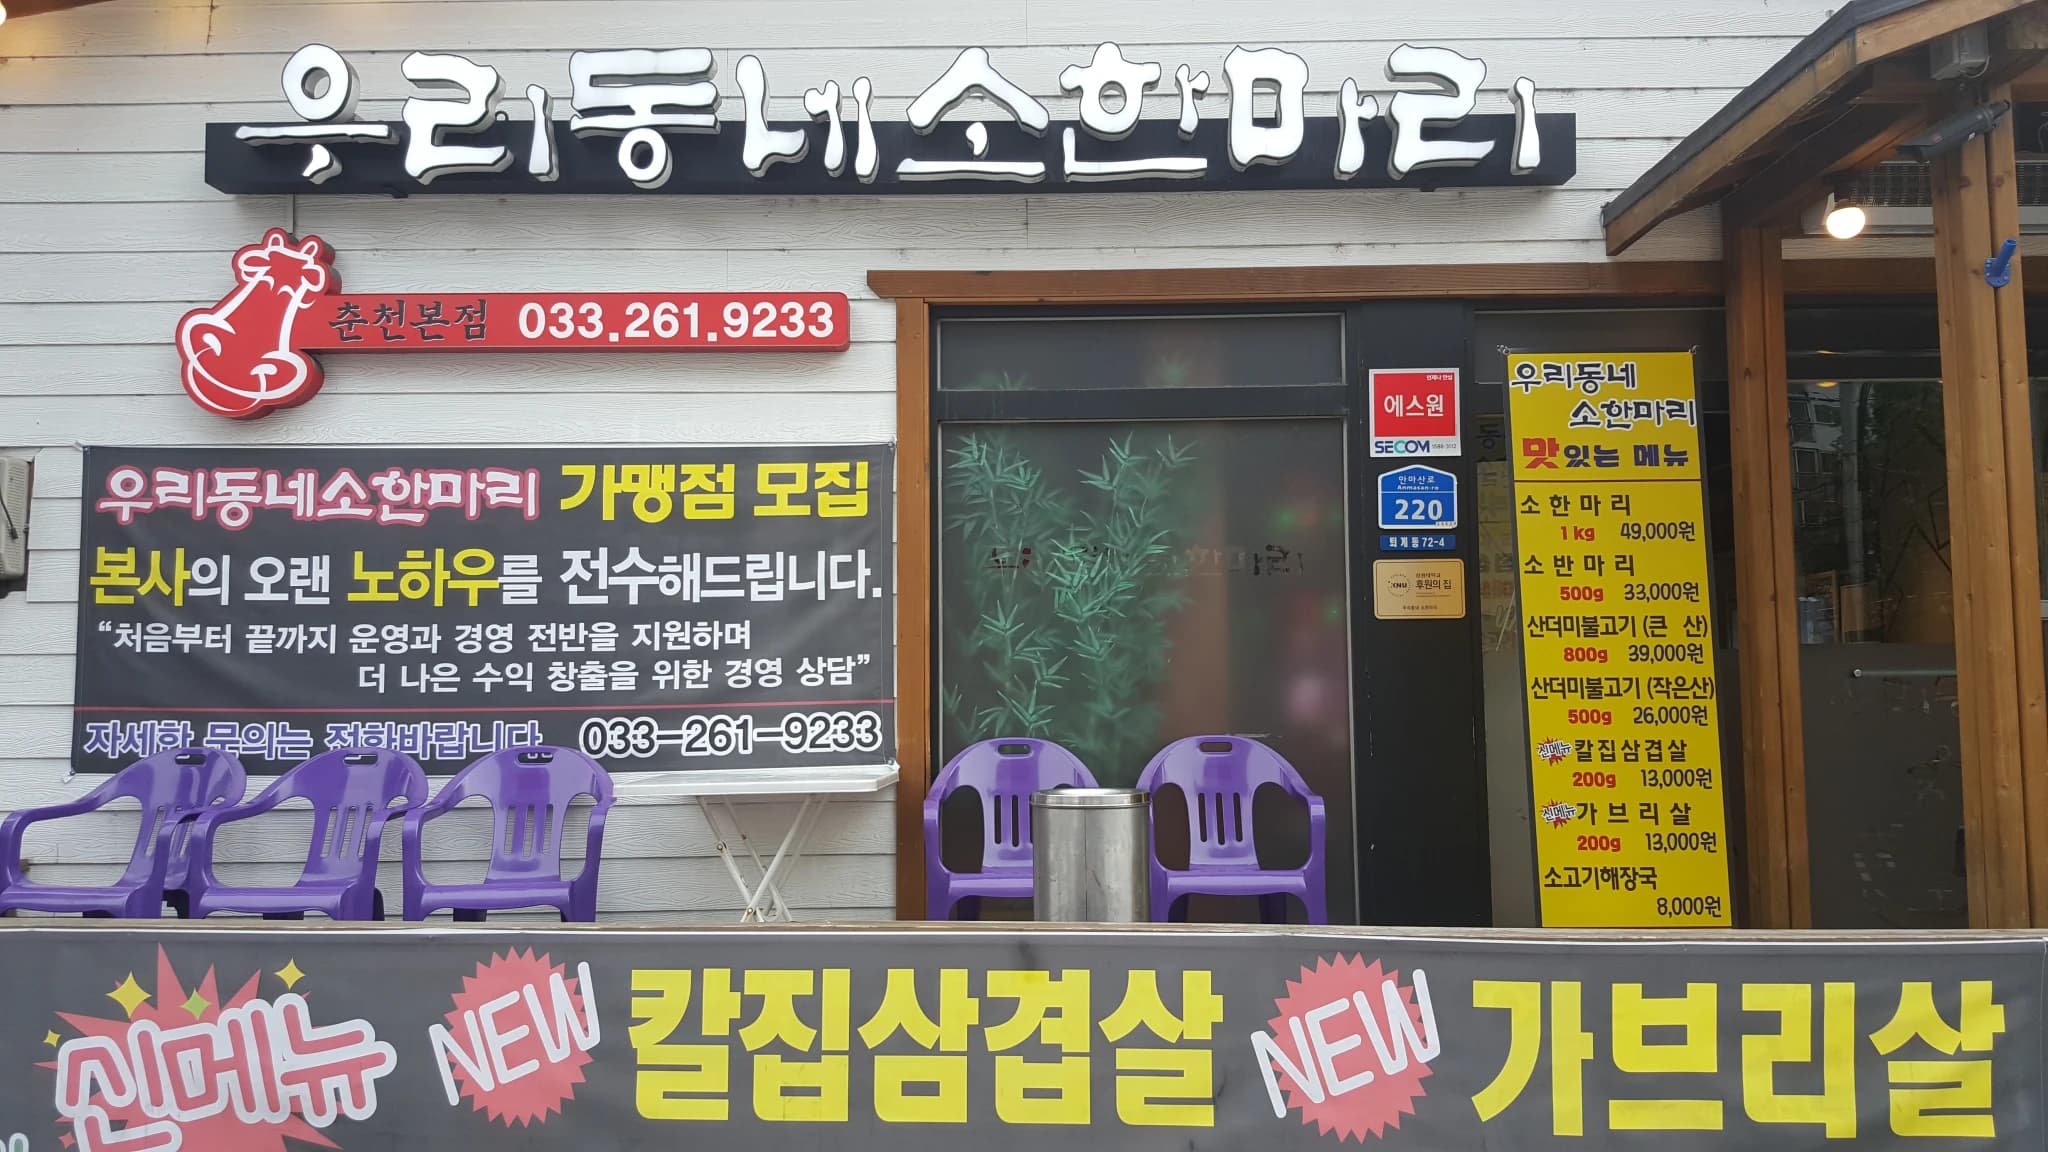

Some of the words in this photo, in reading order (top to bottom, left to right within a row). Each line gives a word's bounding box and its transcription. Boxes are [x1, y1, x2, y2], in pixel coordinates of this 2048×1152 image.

[235, 42, 1540, 188] 우리동네소한마리
[328, 298, 488, 342] 춘천본점
[517, 301, 835, 342] 033.261.9233
[1510, 361, 1637, 394] 우리동네
[1383, 393, 1444, 417] 에스원
[1568, 399, 1697, 430] 소한마리
[1374, 439, 1431, 454] SECOM
[1521, 437, 1620, 469] 맛있는
[1633, 444, 1689, 467] 메뉴
[1398, 475, 1436, 485] 안마산로
[96, 465, 540, 531] 우리동네소한마리
[560, 463, 736, 523] 가맹점
[753, 461, 869, 518] 모집
[1394, 498, 1443, 521] 220
[1421, 536, 1445, 548] 72-4
[1620, 521, 1696, 542] 49,000원
[89, 546, 231, 607] 본사의
[244, 554, 331, 605] 오랜
[347, 548, 543, 607] 노하우를
[560, 546, 883, 605] 전수해드립니다.
[1415, 579, 1441, 590] 후원의
[1443, 579, 1452, 590] 집
[1559, 586, 1604, 603] 500g
[1623, 582, 1700, 603] 33,000원
[98, 620, 232, 654] “처음부터
[245, 623, 337, 655] 끝까지
[348, 623, 442, 654] 운영과
[454, 622, 514, 654] 경영
[527, 621, 620, 653] 전반을
[631, 619, 751, 650] 지원하며
[1527, 615, 1637, 638] 산더미불고기
[1563, 647, 1608, 664] 800g
[1628, 643, 1704, 665] 39,000원
[358, 663, 385, 694] 더
[400, 663, 461, 693] 나은
[471, 661, 533, 692] 수익
[546, 660, 639, 692] 창출을
[651, 658, 712, 690] 위한
[725, 657, 784, 688] 경영
[796, 653, 871, 687] 상담”
[1531, 676, 1641, 700] 산더미불고기
[1646, 676, 1715, 700] (작은산)
[1567, 709, 1612, 726] 500g
[1632, 706, 1709, 727] 26,000원
[578, 711, 882, 758] 033-261-9233
[1574, 739, 1688, 763] 칼집삼겹살
[1572, 771, 1617, 789] 200g
[1640, 768, 1713, 790] 13,000원
[1577, 835, 1621, 853] 200g
[1645, 831, 1717, 853] 13,000원
[1543, 866, 1658, 892] 소고기해장국
[1656, 896, 1722, 918] 8,000원
[428, 961, 601, 1106] NEW
[1250, 968, 1441, 1120] NEW
[628, 968, 1224, 1127] 칼집삼겹살
[1471, 979, 2007, 1139] 가브리살
[55, 993, 397, 1152] 신메뉴
